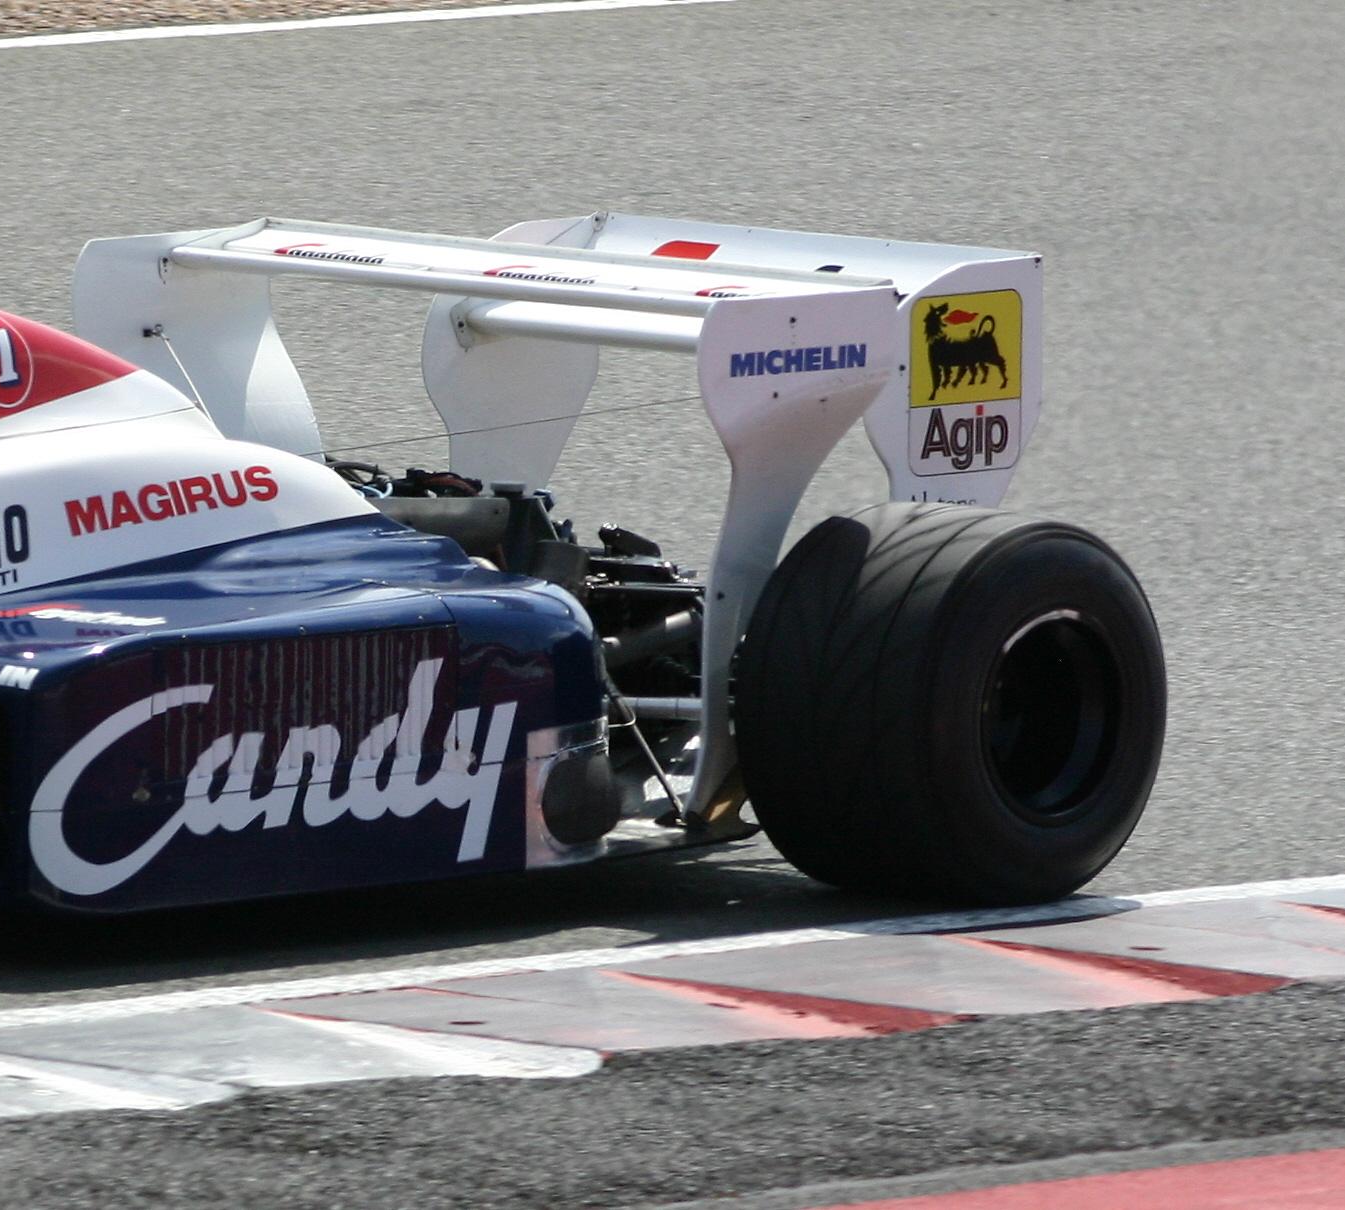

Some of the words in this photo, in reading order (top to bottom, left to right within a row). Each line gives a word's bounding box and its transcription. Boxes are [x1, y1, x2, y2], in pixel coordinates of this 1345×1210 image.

[729, 343, 867, 378] MICHELIN
[920, 404, 1009, 471] Agip
[63, 465, 279, 537] MAGIRUS
[27, 656, 518, 896] Candy
